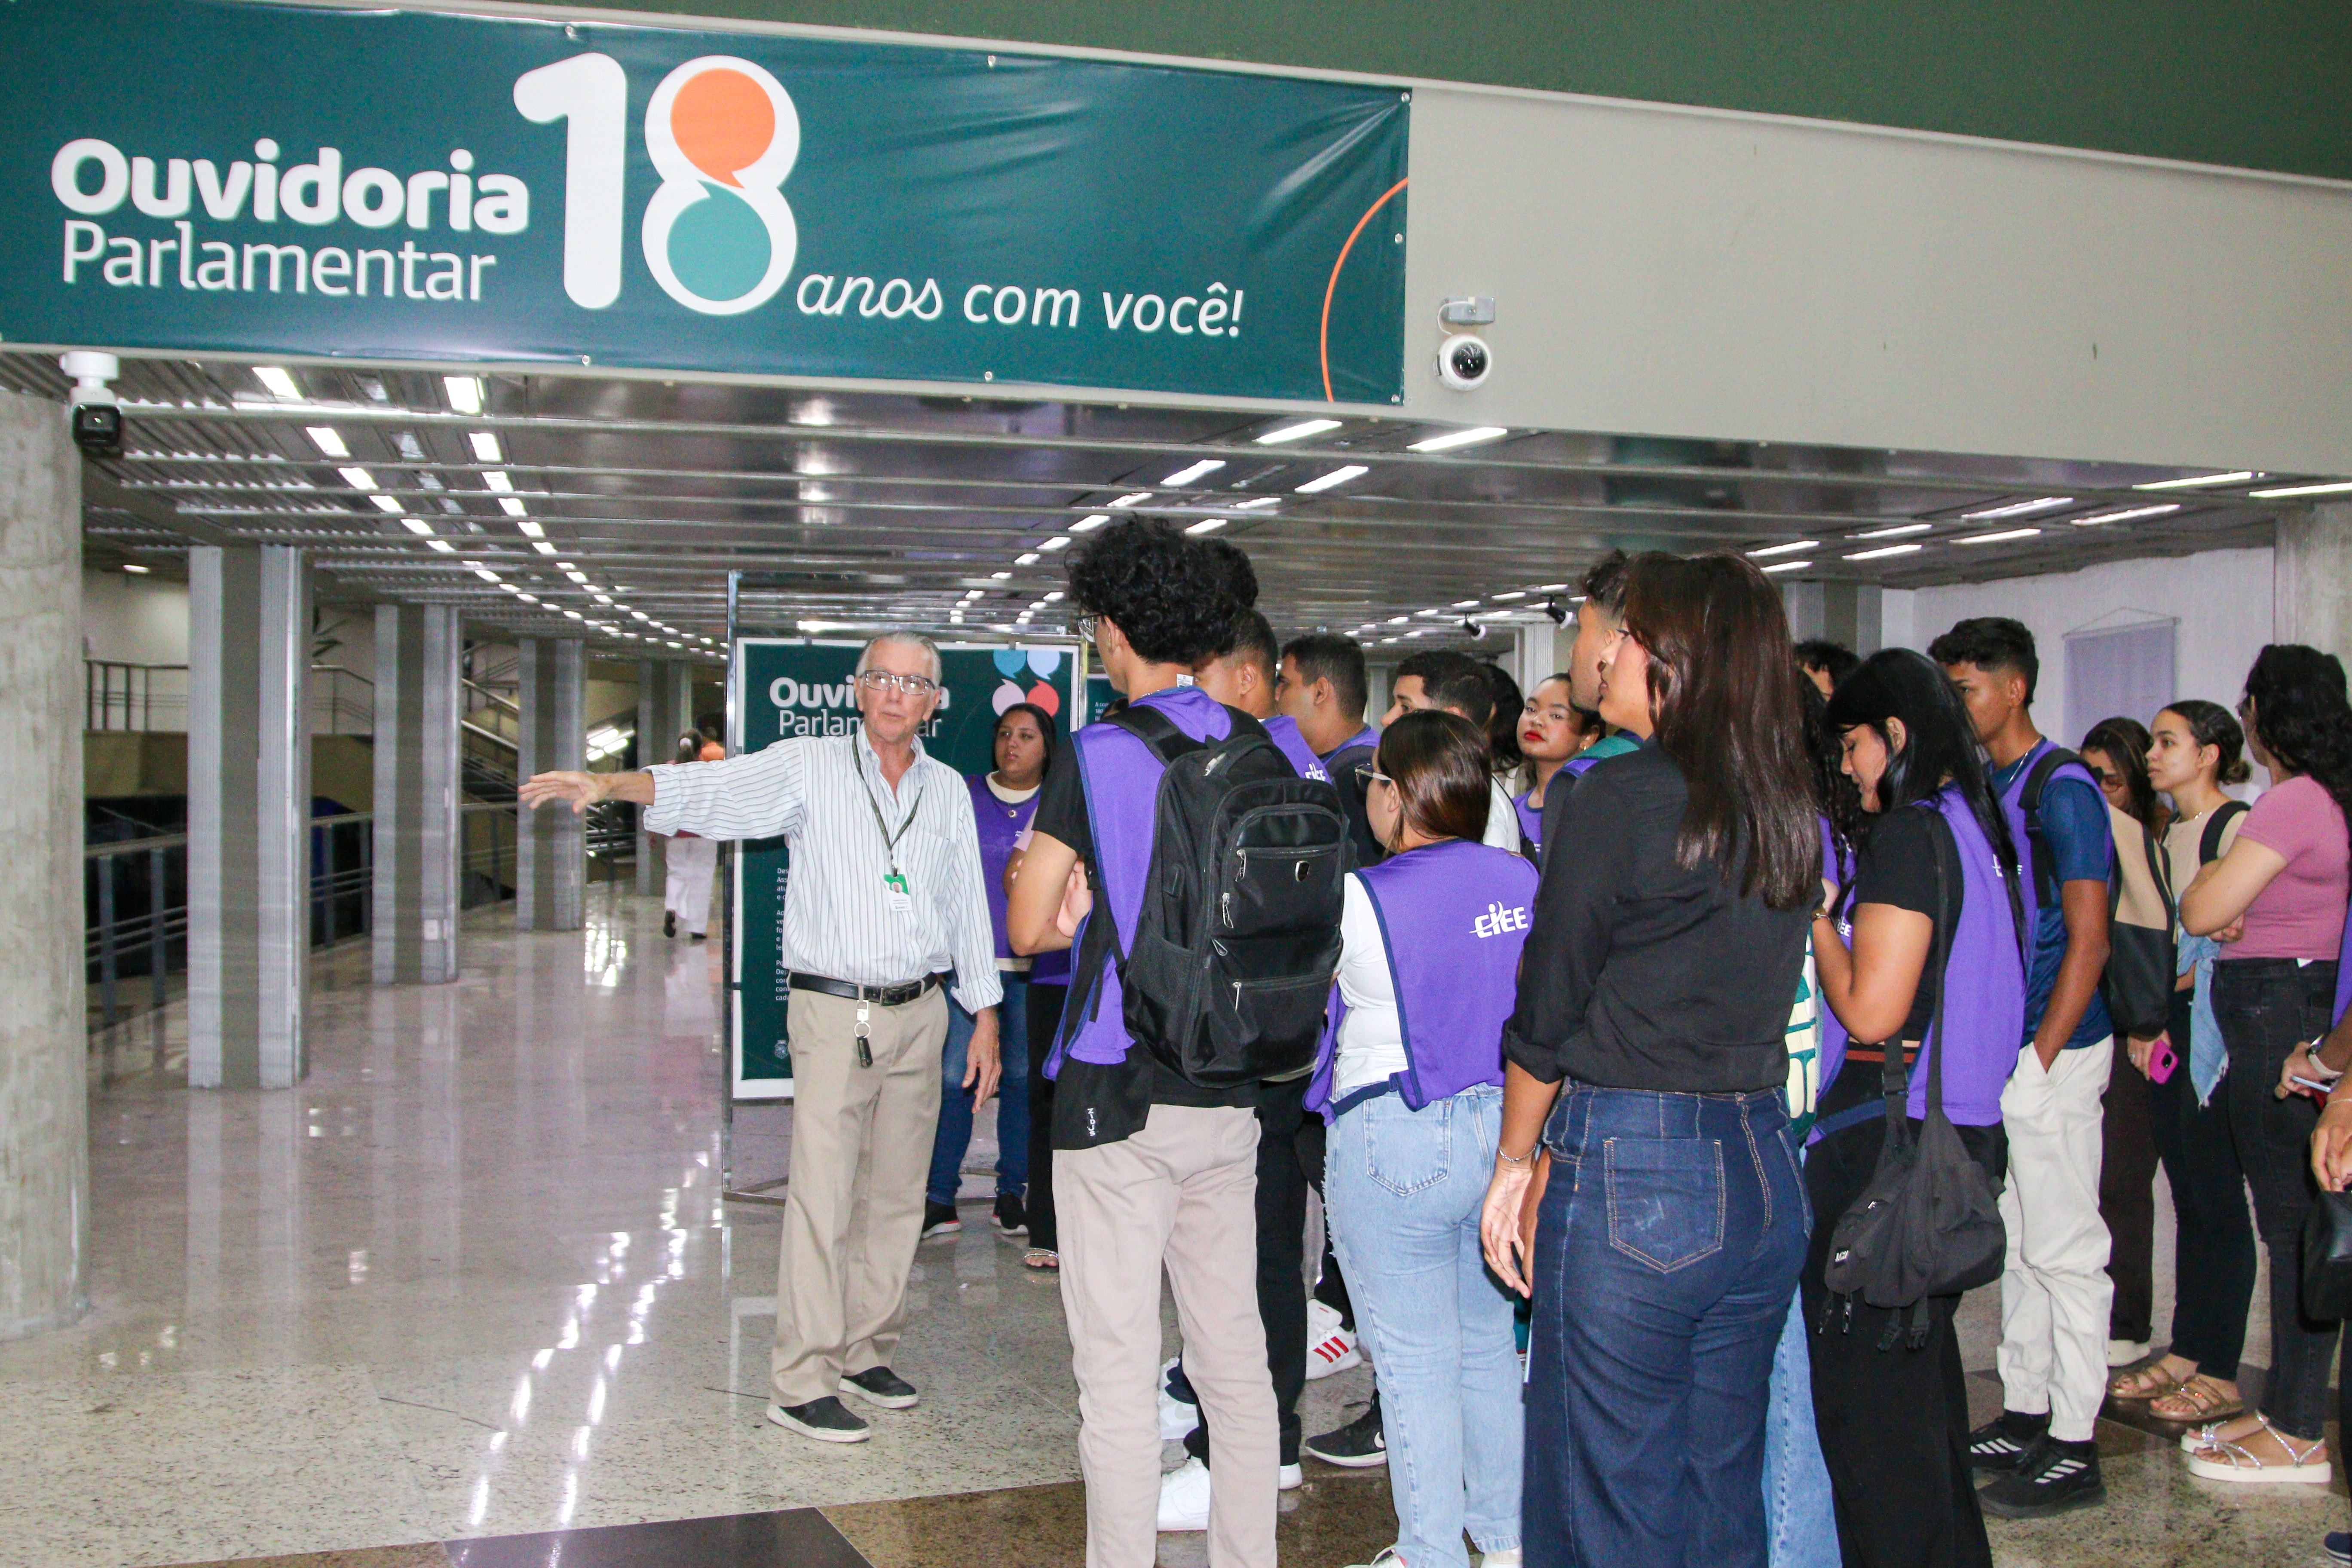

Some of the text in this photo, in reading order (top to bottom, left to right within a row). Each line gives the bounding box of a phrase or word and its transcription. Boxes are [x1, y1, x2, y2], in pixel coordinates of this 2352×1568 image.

[52, 138, 529, 234] Ouvidoria
[513, 52, 799, 315] 18
[64, 220, 496, 300] Parlamentar
[796, 274, 1243, 337] anos com você!
[769, 674, 949, 709] Ouvia
[1469, 900, 1528, 938] CIEE
